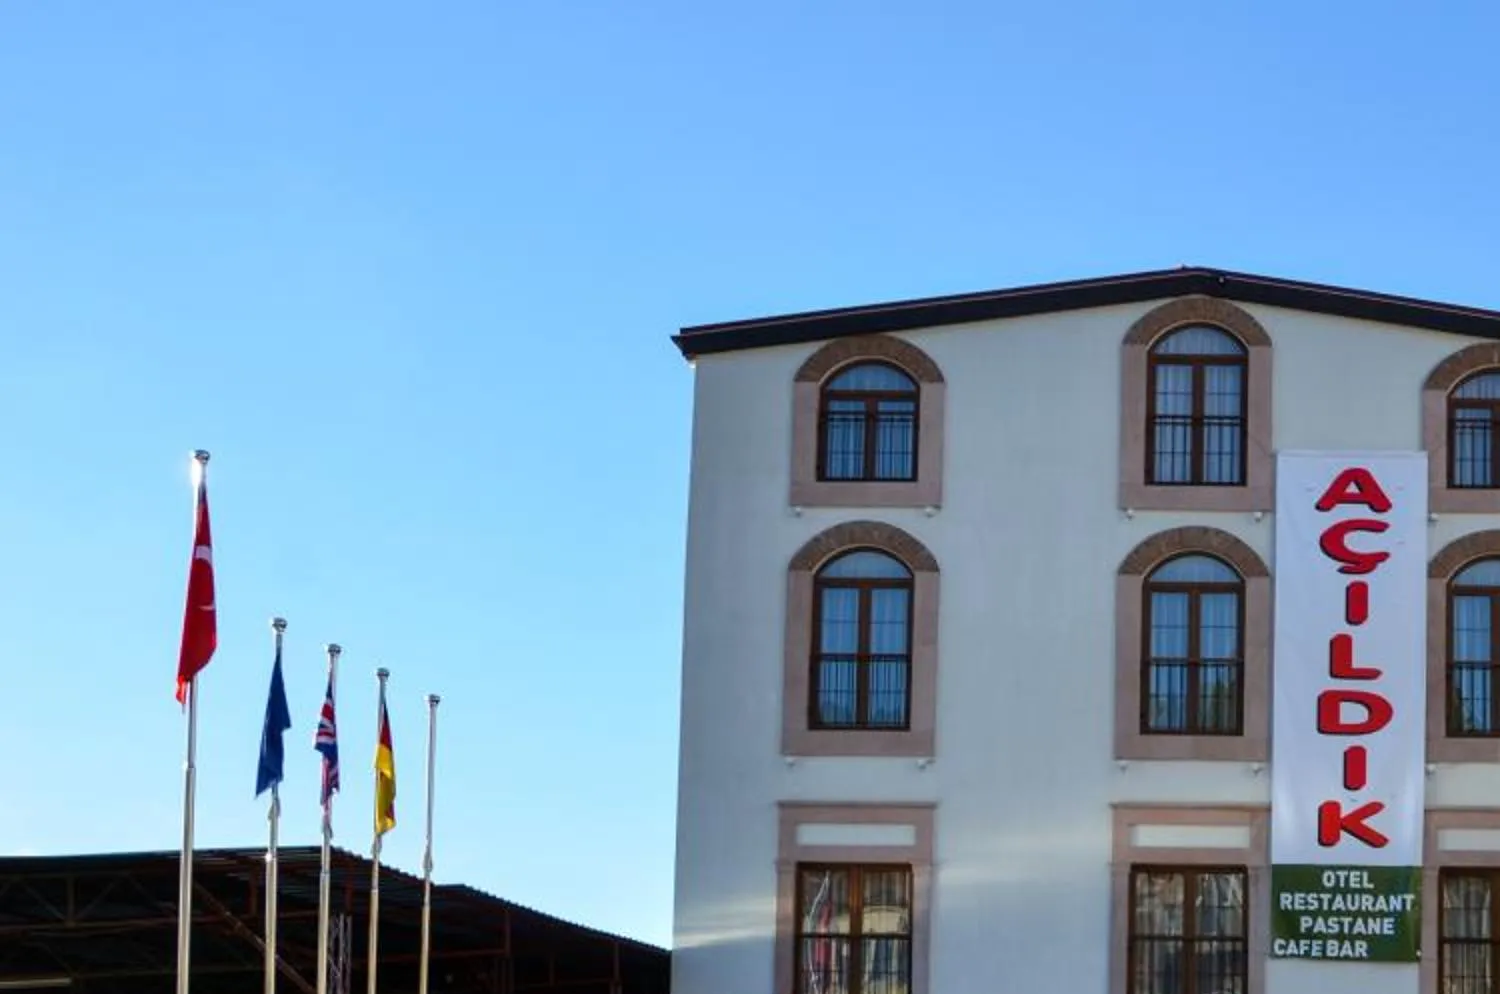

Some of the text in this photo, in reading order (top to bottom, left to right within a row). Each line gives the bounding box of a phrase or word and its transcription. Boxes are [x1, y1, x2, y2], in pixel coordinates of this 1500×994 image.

[1314, 466, 1393, 848] AÇILDIK
[1322, 870, 1375, 889] OTEL
[1279, 893, 1416, 912] RESTAURANT
[1299, 916, 1396, 935] PASTANE
[1273, 938, 1369, 957] CAFE BAR
